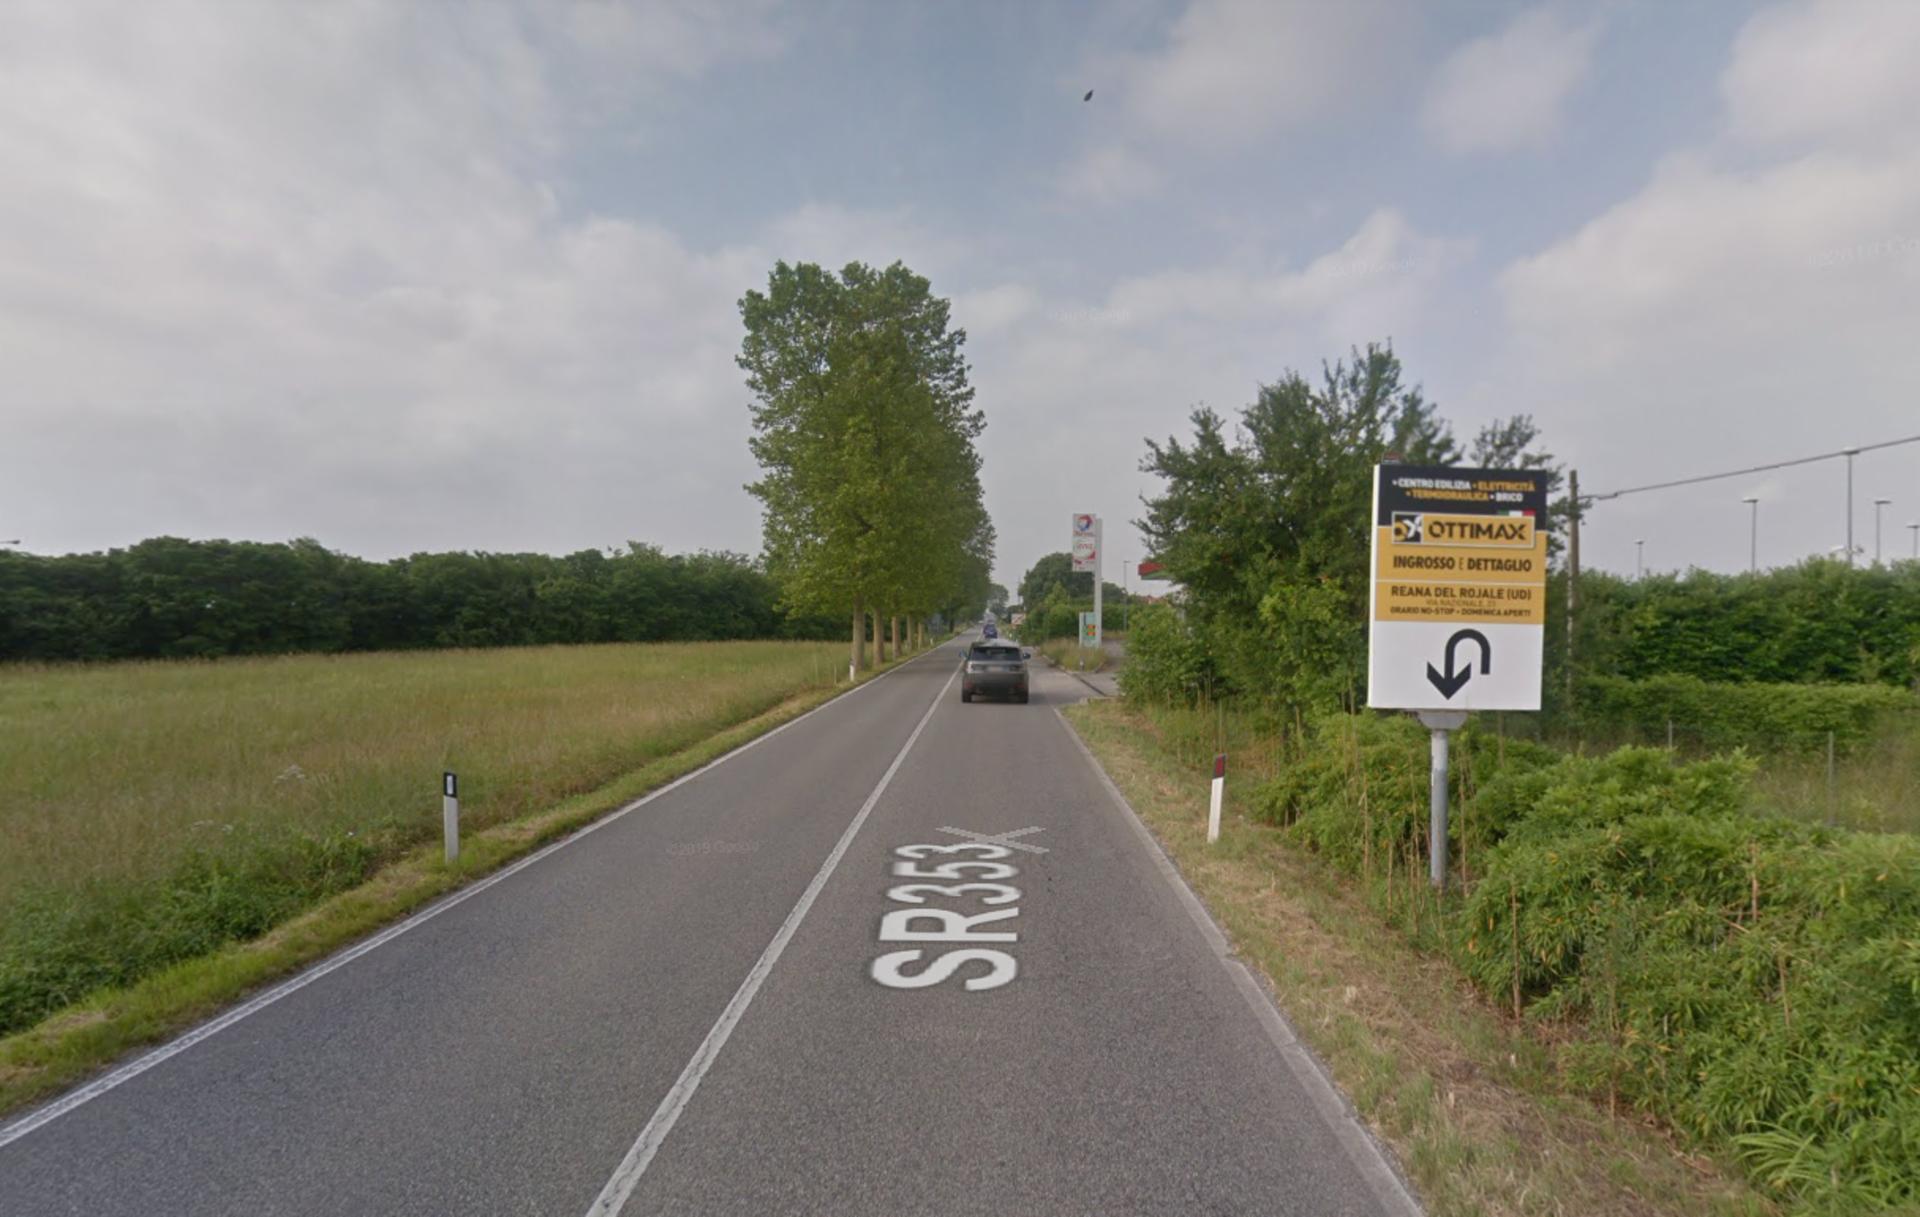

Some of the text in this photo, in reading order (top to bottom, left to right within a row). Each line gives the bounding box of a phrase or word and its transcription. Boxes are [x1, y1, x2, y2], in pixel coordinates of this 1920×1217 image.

[1428, 521, 1527, 540] OTTIMAX
[1393, 555, 1455, 570] INGROSSO
[1467, 558, 1532, 572] DETTAGLIO
[1391, 586, 1532, 601] REANA DEL ROJALE (UD)
